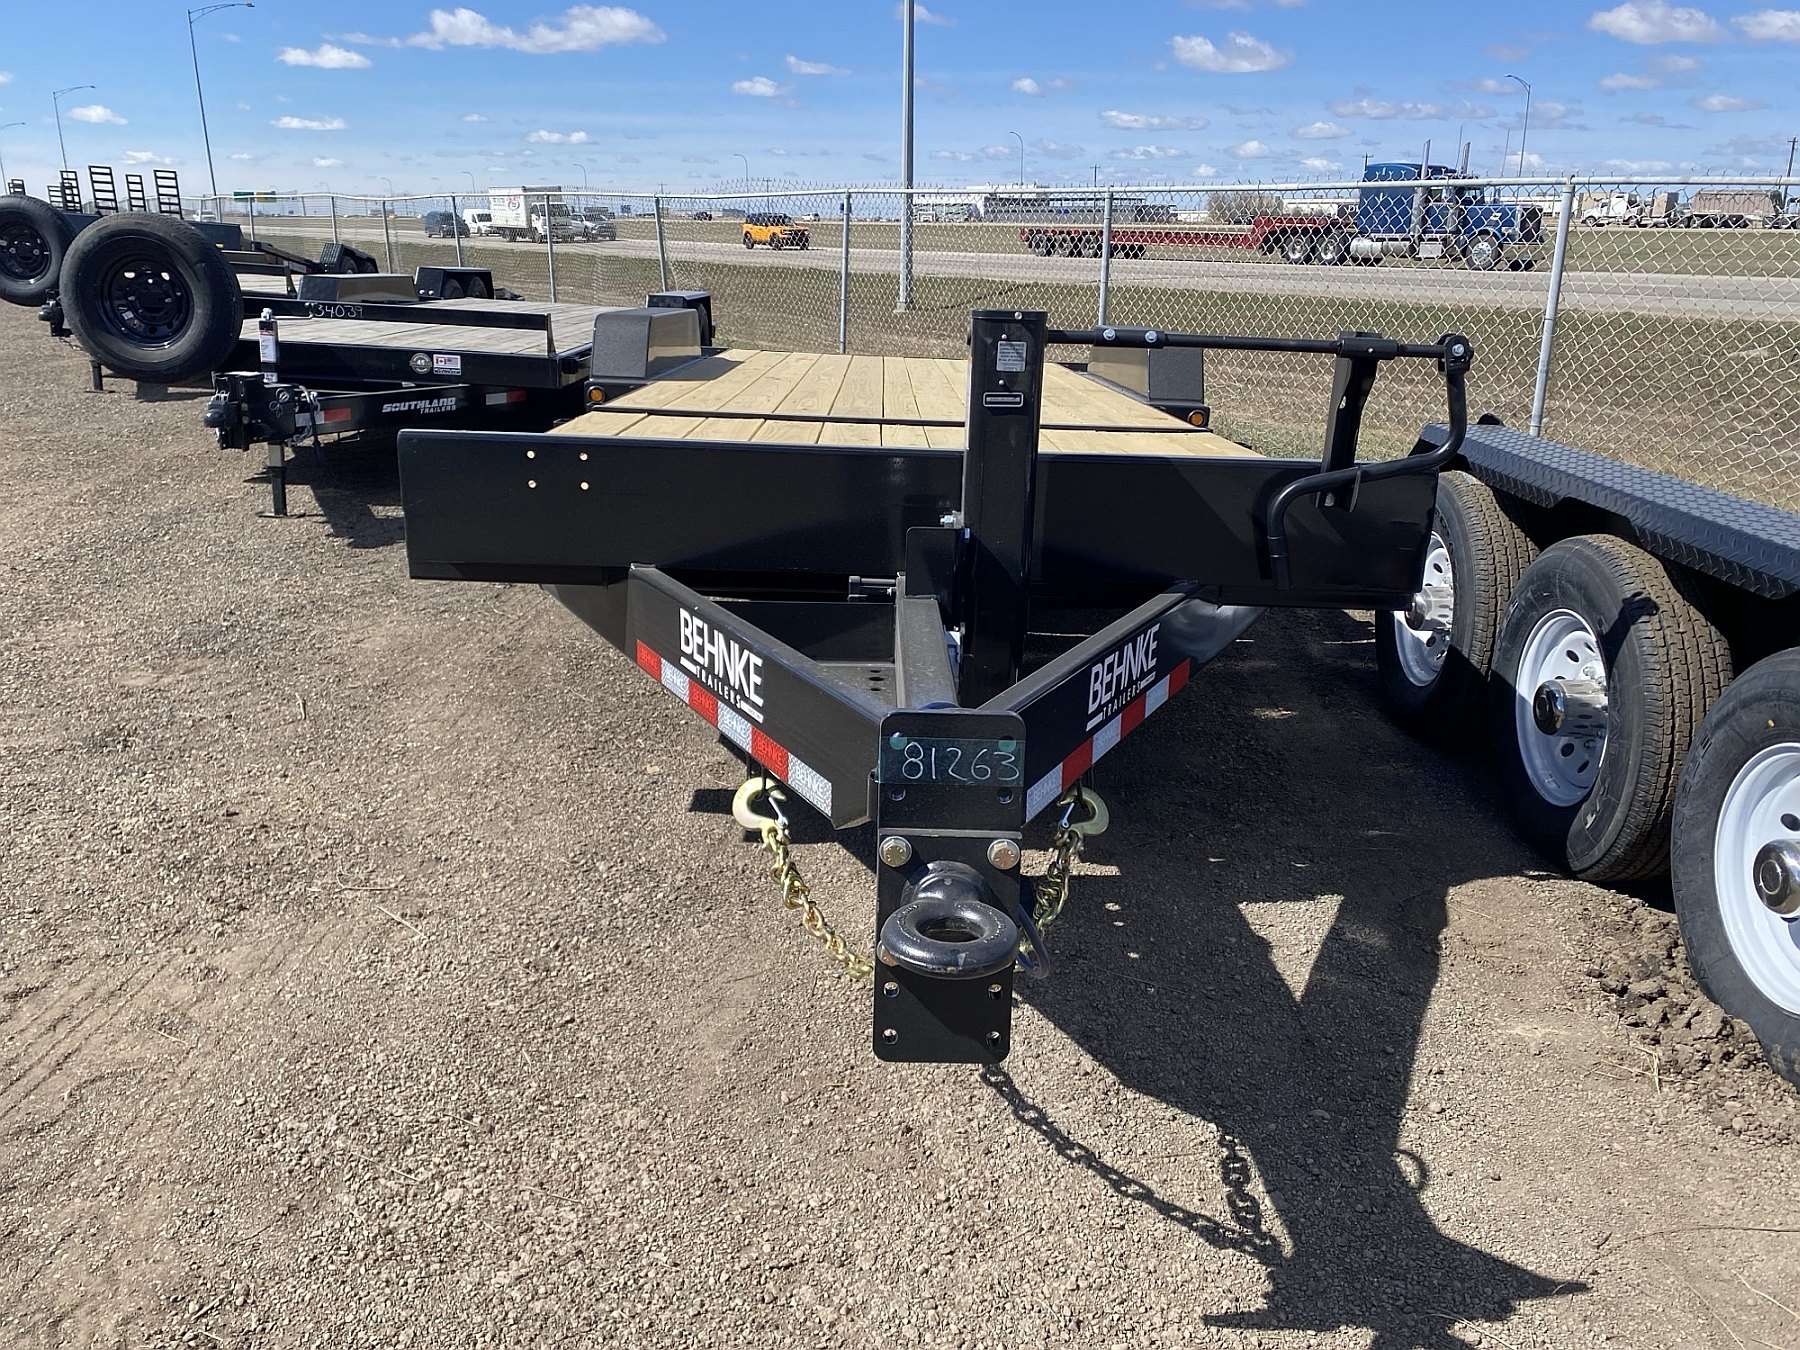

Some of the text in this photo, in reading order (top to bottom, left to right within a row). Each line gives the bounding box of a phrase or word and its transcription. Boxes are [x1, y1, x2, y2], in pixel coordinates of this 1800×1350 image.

[315, 304, 363, 319] 34039
[382, 397, 456, 413] SOUTHLAND
[420, 405, 456, 415] TRAILERS
[680, 607, 764, 707] BEHNKE
[1087, 622, 1160, 715] BEHNKE
[696, 666, 741, 709] TRAILERS
[1102, 680, 1142, 720] TRAILERS
[902, 741, 1020, 781] 81263
